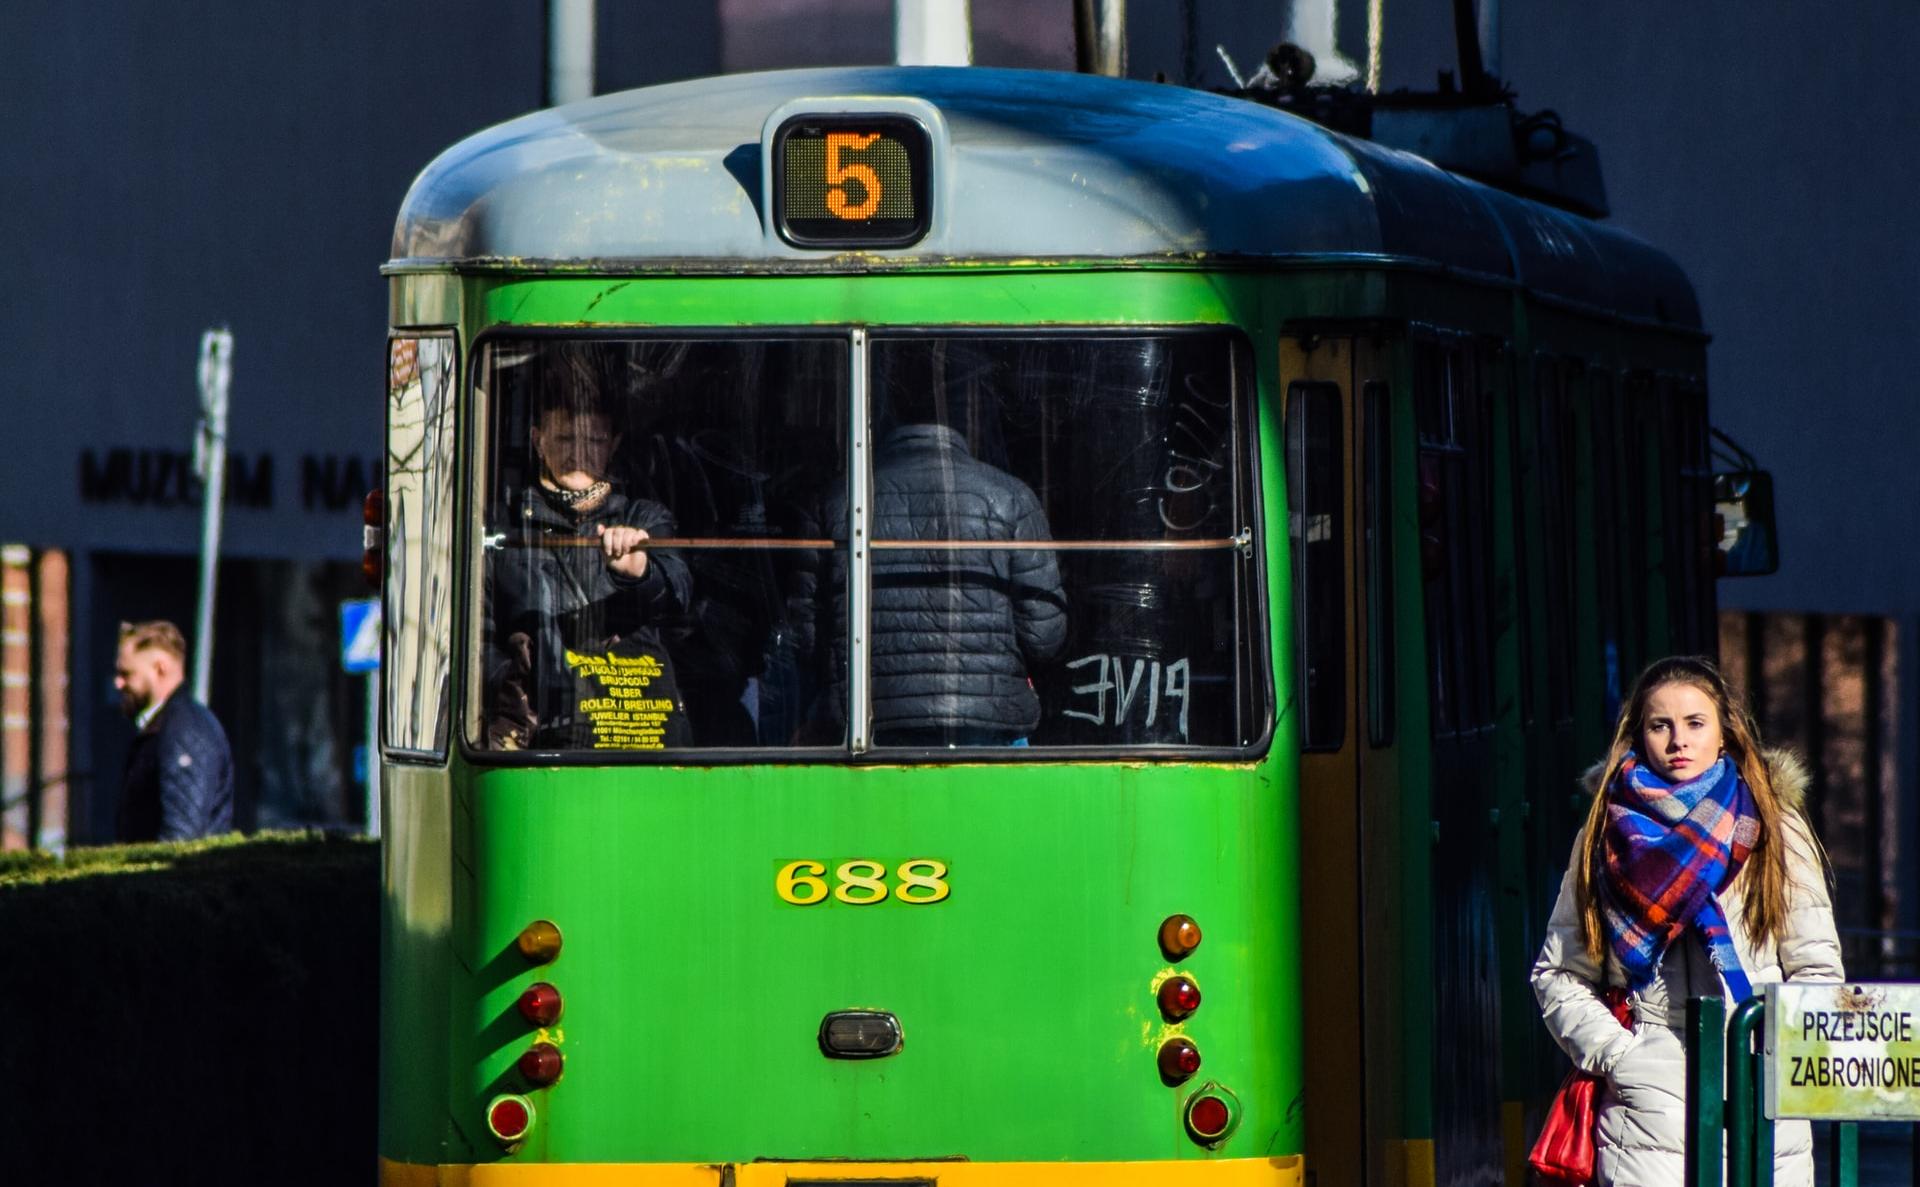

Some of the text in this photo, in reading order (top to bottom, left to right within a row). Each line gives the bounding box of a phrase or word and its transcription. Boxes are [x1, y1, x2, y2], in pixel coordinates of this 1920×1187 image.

[826, 132, 881, 219] 5
[580, 699, 617, 712] ROLEX
[624, 699, 673, 711] BREITLING
[609, 687, 642, 698] SILBER
[775, 859, 951, 906] 688
[1803, 1006, 1912, 1042] PRZEJŚCIE
